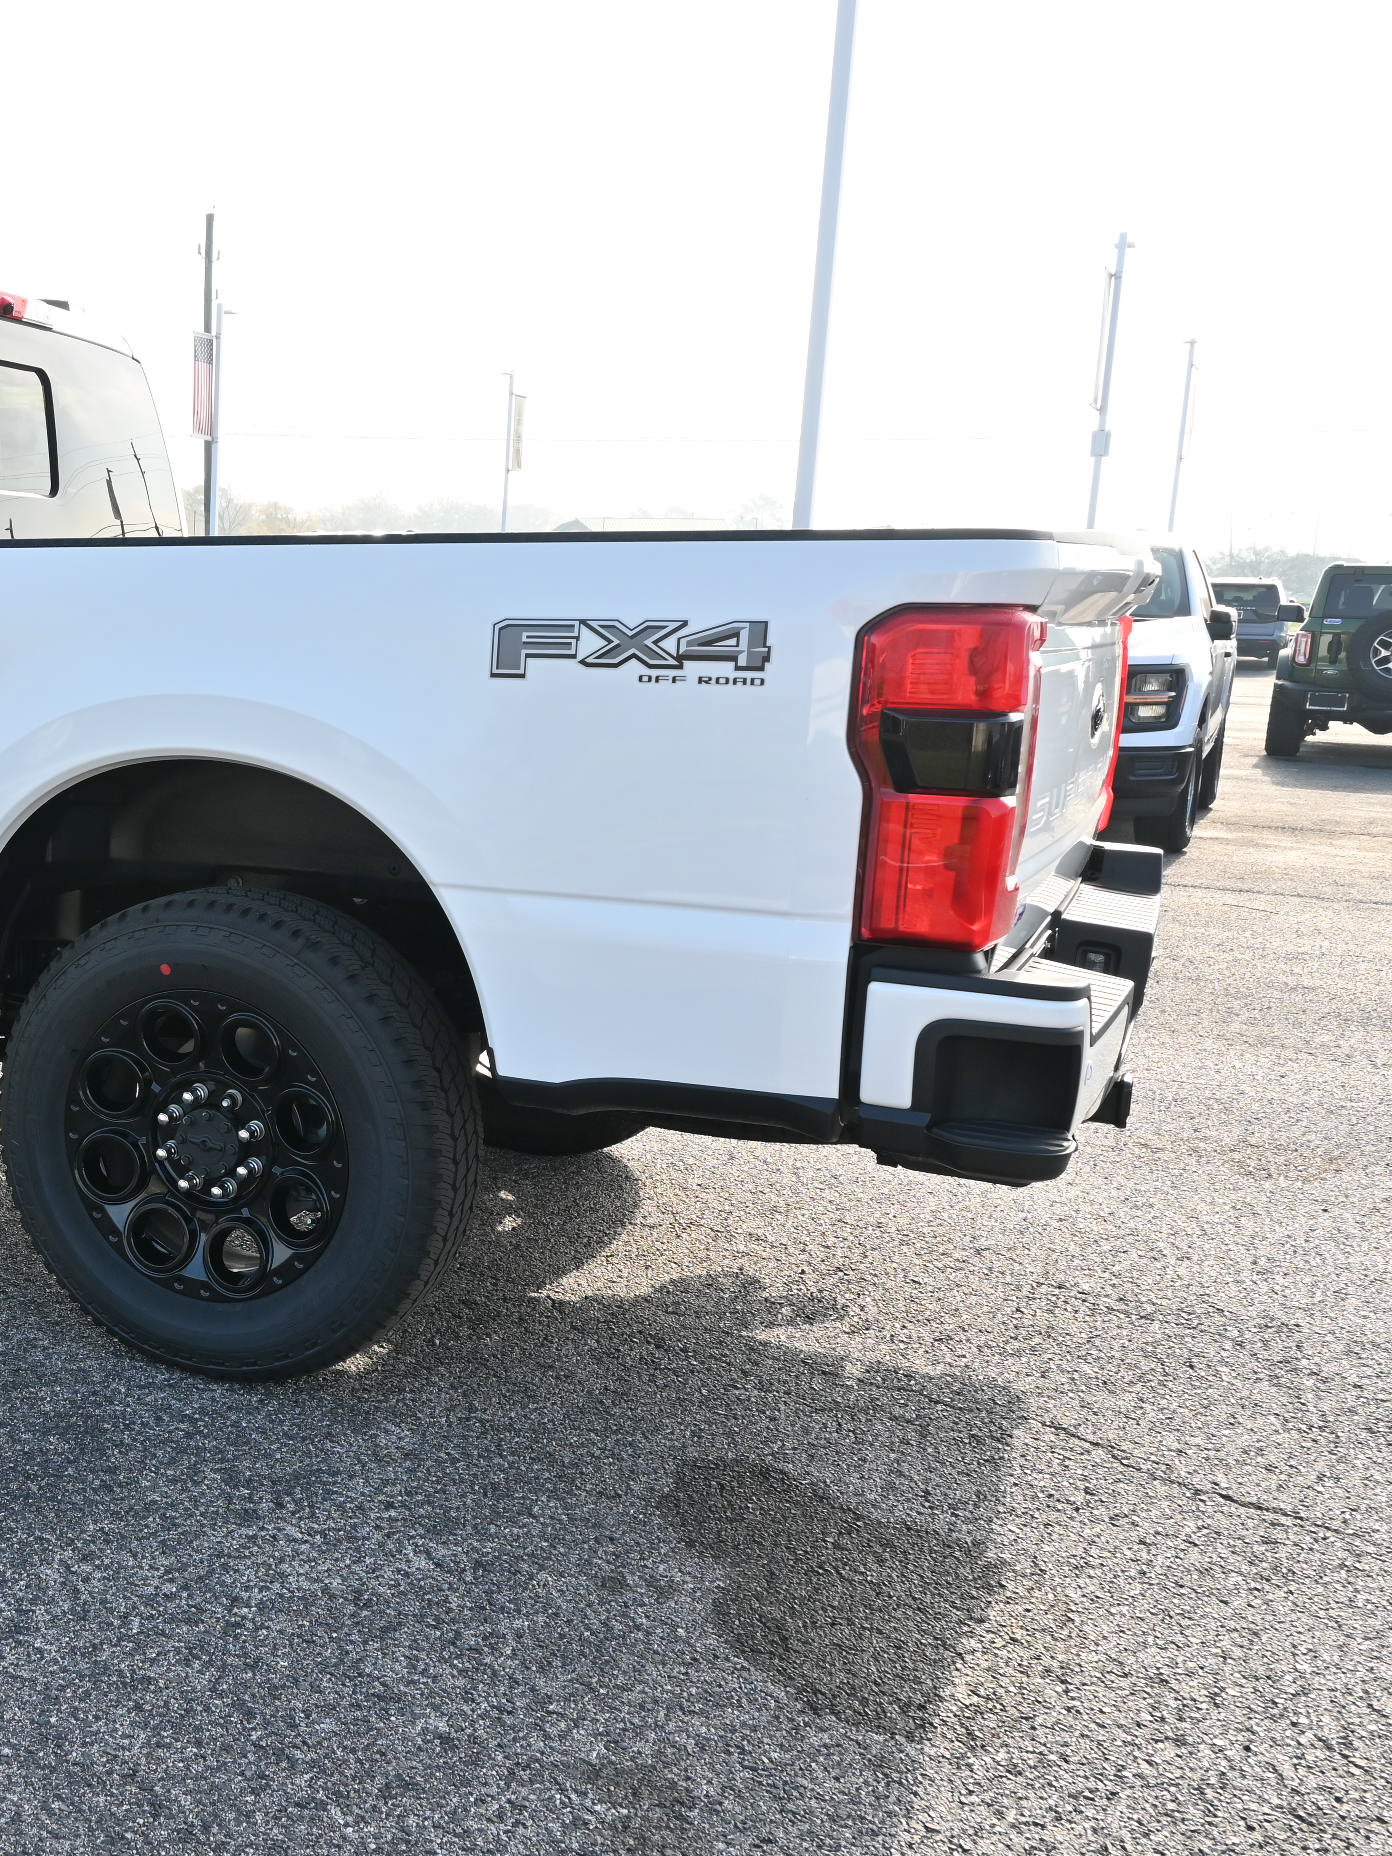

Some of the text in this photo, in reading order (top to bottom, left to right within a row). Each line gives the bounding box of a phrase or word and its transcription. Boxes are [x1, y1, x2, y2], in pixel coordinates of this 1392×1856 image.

[490, 618, 772, 679] FX4
[638, 674, 766, 687] OFF ROAD
